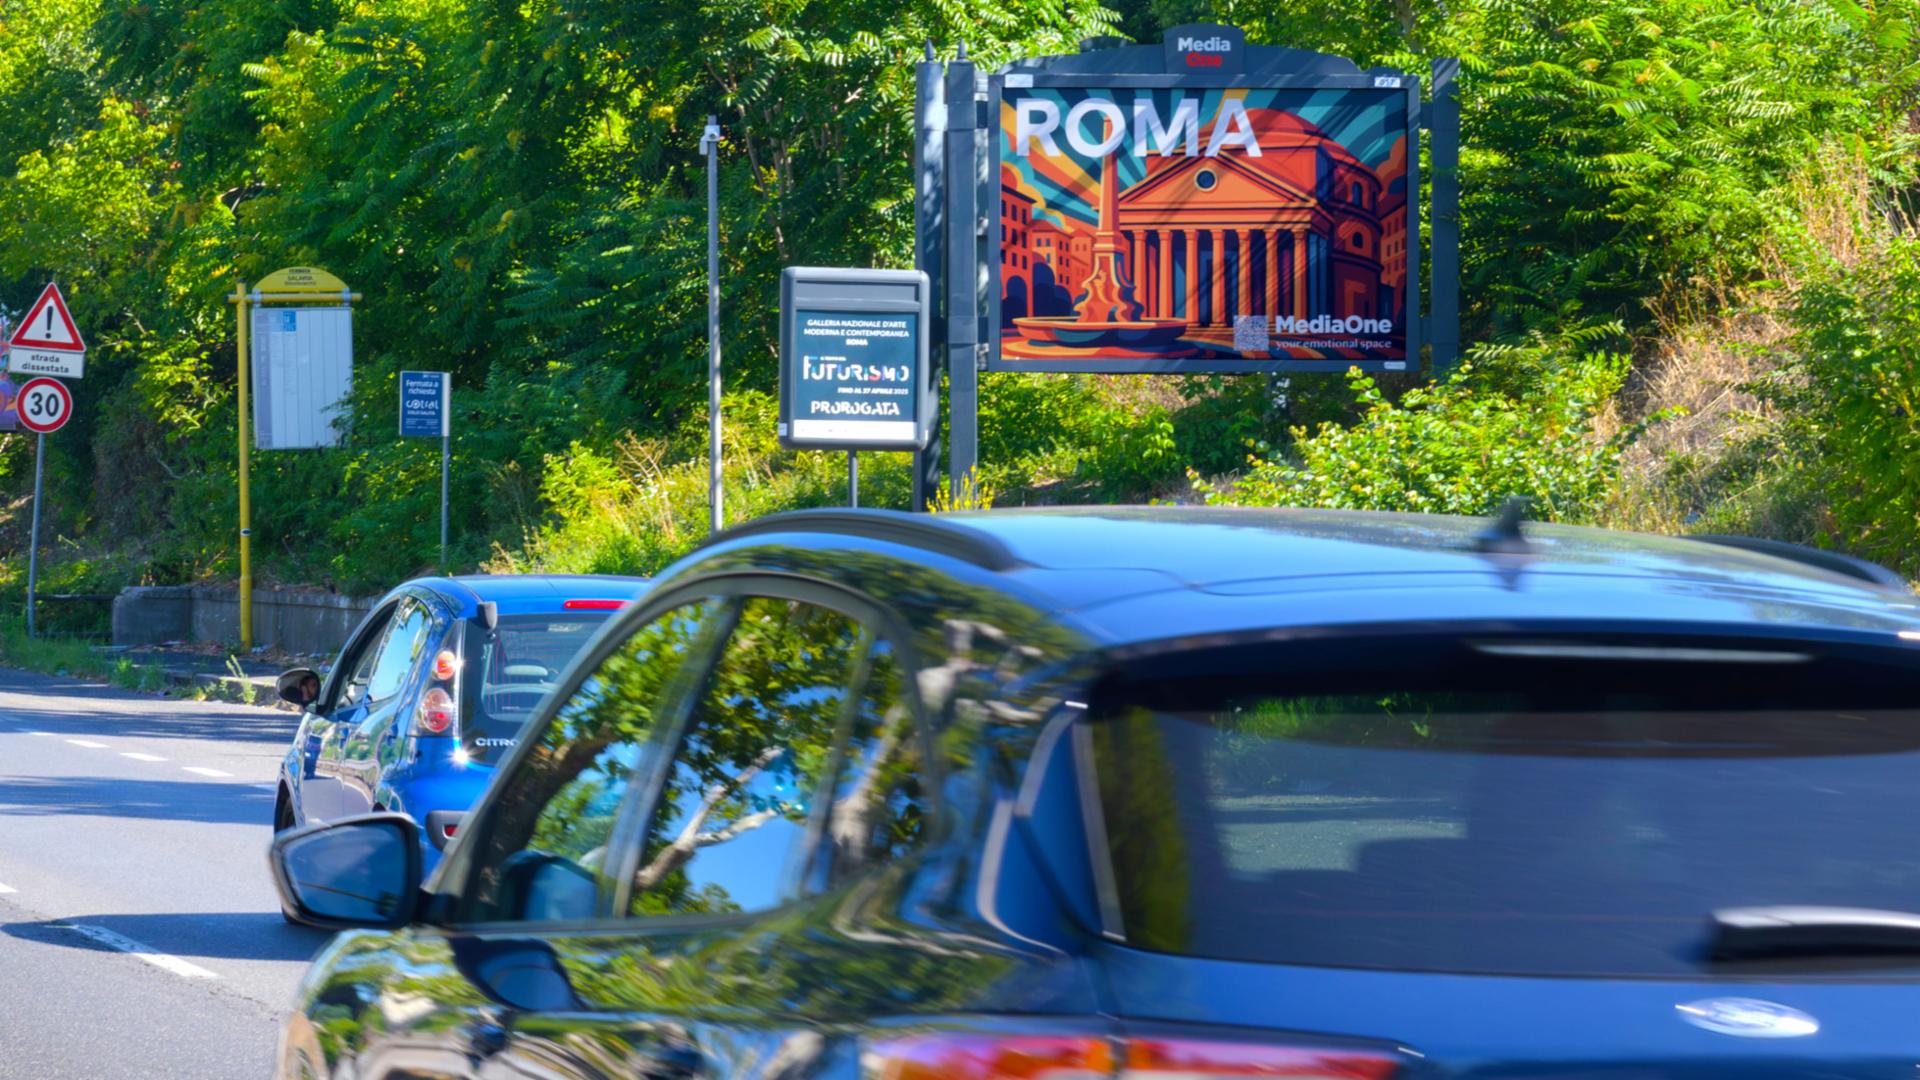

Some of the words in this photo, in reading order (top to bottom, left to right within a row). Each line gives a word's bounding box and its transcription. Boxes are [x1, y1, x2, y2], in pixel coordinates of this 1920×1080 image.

[1177, 36, 1231, 52] Media
[1185, 51, 1223, 68] One
[1016, 97, 1263, 158] ROMA
[1275, 314, 1393, 334] MediaOne
[804, 328, 840, 336] MODERNA
[846, 329, 910, 337] CONTEMPORANEA
[1276, 340, 1302, 350] your
[1303, 338, 1358, 348] emotional
[1360, 339, 1392, 350] space
[31, 354, 60, 362] strada
[22, 362, 70, 373] dissestata
[803, 355, 910, 382] FUTURISMO
[406, 379, 433, 387] Fermata
[408, 387, 436, 395] richiesta
[871, 387, 893, 395] APRILE
[30, 392, 59, 417] 30
[810, 401, 901, 416] PROROGATA
